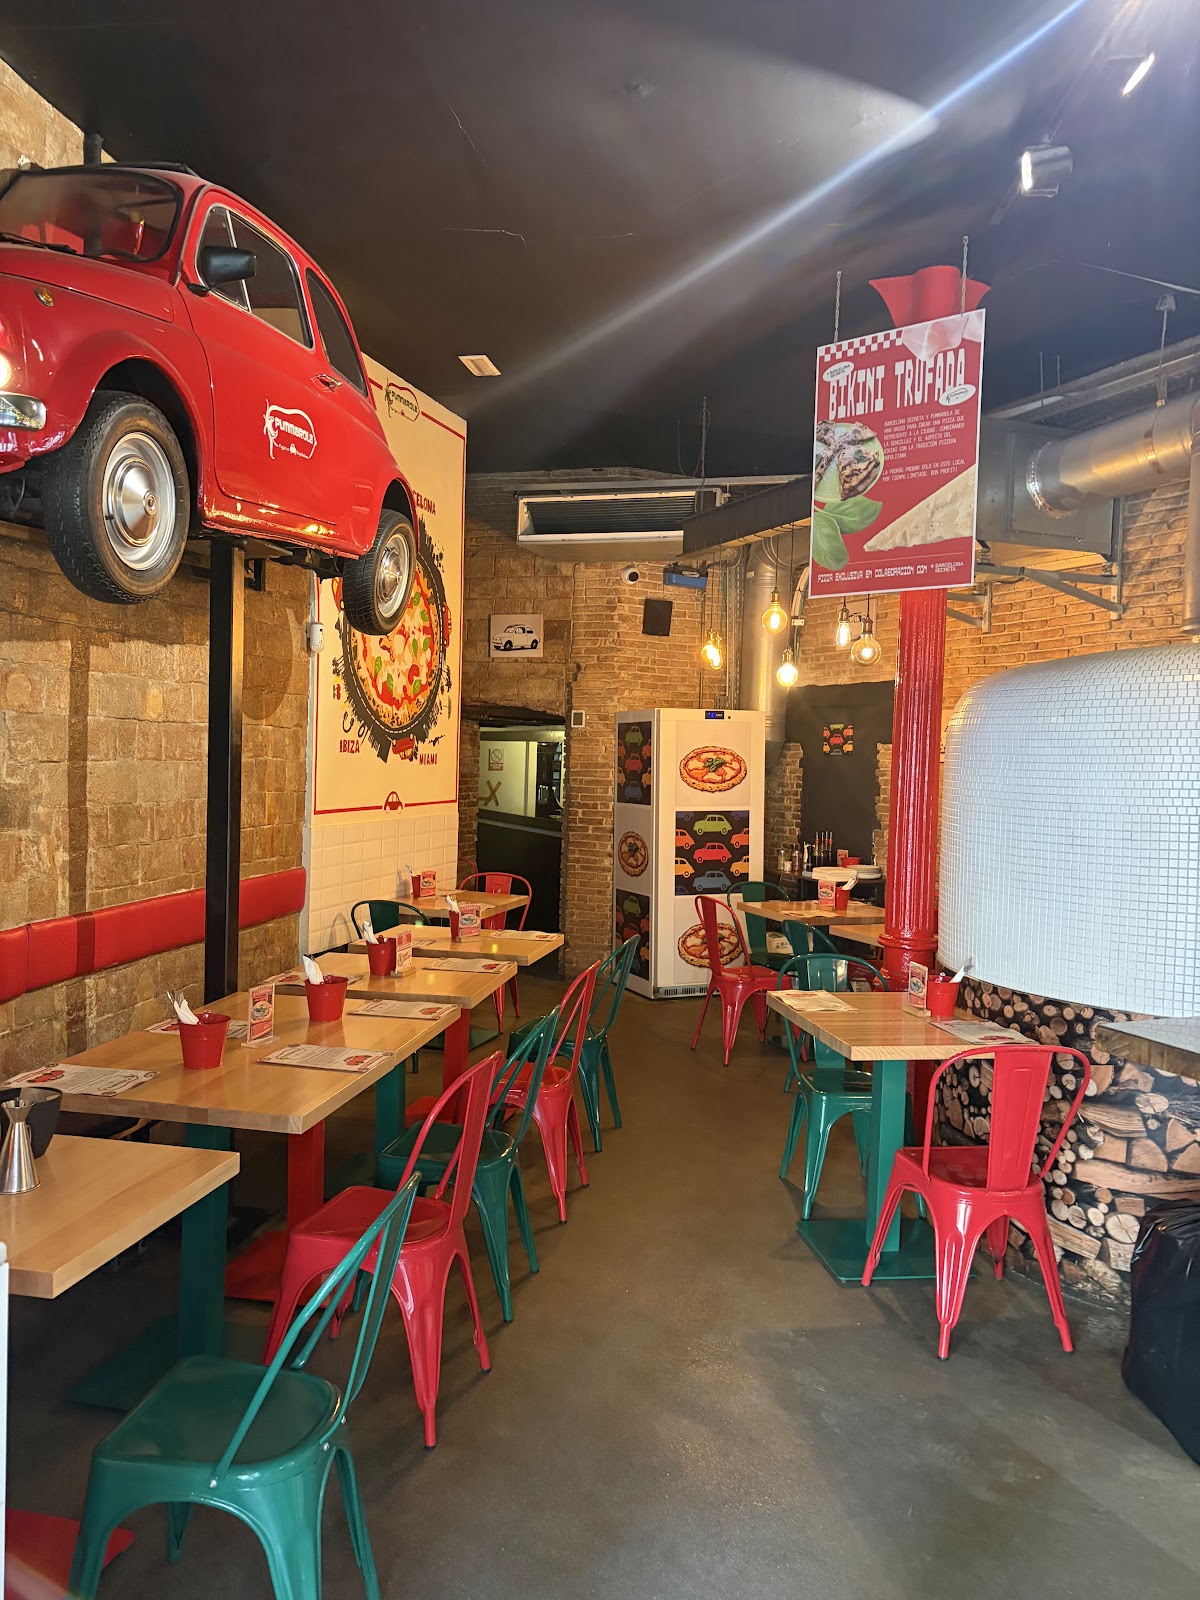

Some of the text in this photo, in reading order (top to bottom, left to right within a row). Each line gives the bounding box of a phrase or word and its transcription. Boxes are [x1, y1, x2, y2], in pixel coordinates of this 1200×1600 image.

[829, 348, 965, 421] BIKINI TRUFADA
[884, 419, 906, 427] BARCELONA
[907, 415, 924, 424] SECRETA
[930, 411, 953, 419] PUMMAROLA
[893, 425, 906, 433] UNIDO
[942, 417, 955, 425] PIZZA
[883, 431, 908, 440] REPRESENTE
[940, 422, 965, 431] COMBINANDO
[890, 437, 912, 446] SENCILLEZ
[924, 433, 943, 441] ASPECTO
[952, 458, 965, 466] LOCAL
[891, 473, 906, 481] TIEMPO
[935, 561, 964, 569] BARCELONA
[817, 573, 834, 583] PIZZA
[835, 570, 864, 582] EXCLUSIVA
[865, 570, 873, 579] EN
[916, 564, 928, 574] CON
[339, 740, 360, 753] IBIZA
[419, 753, 438, 765] MIAMI
